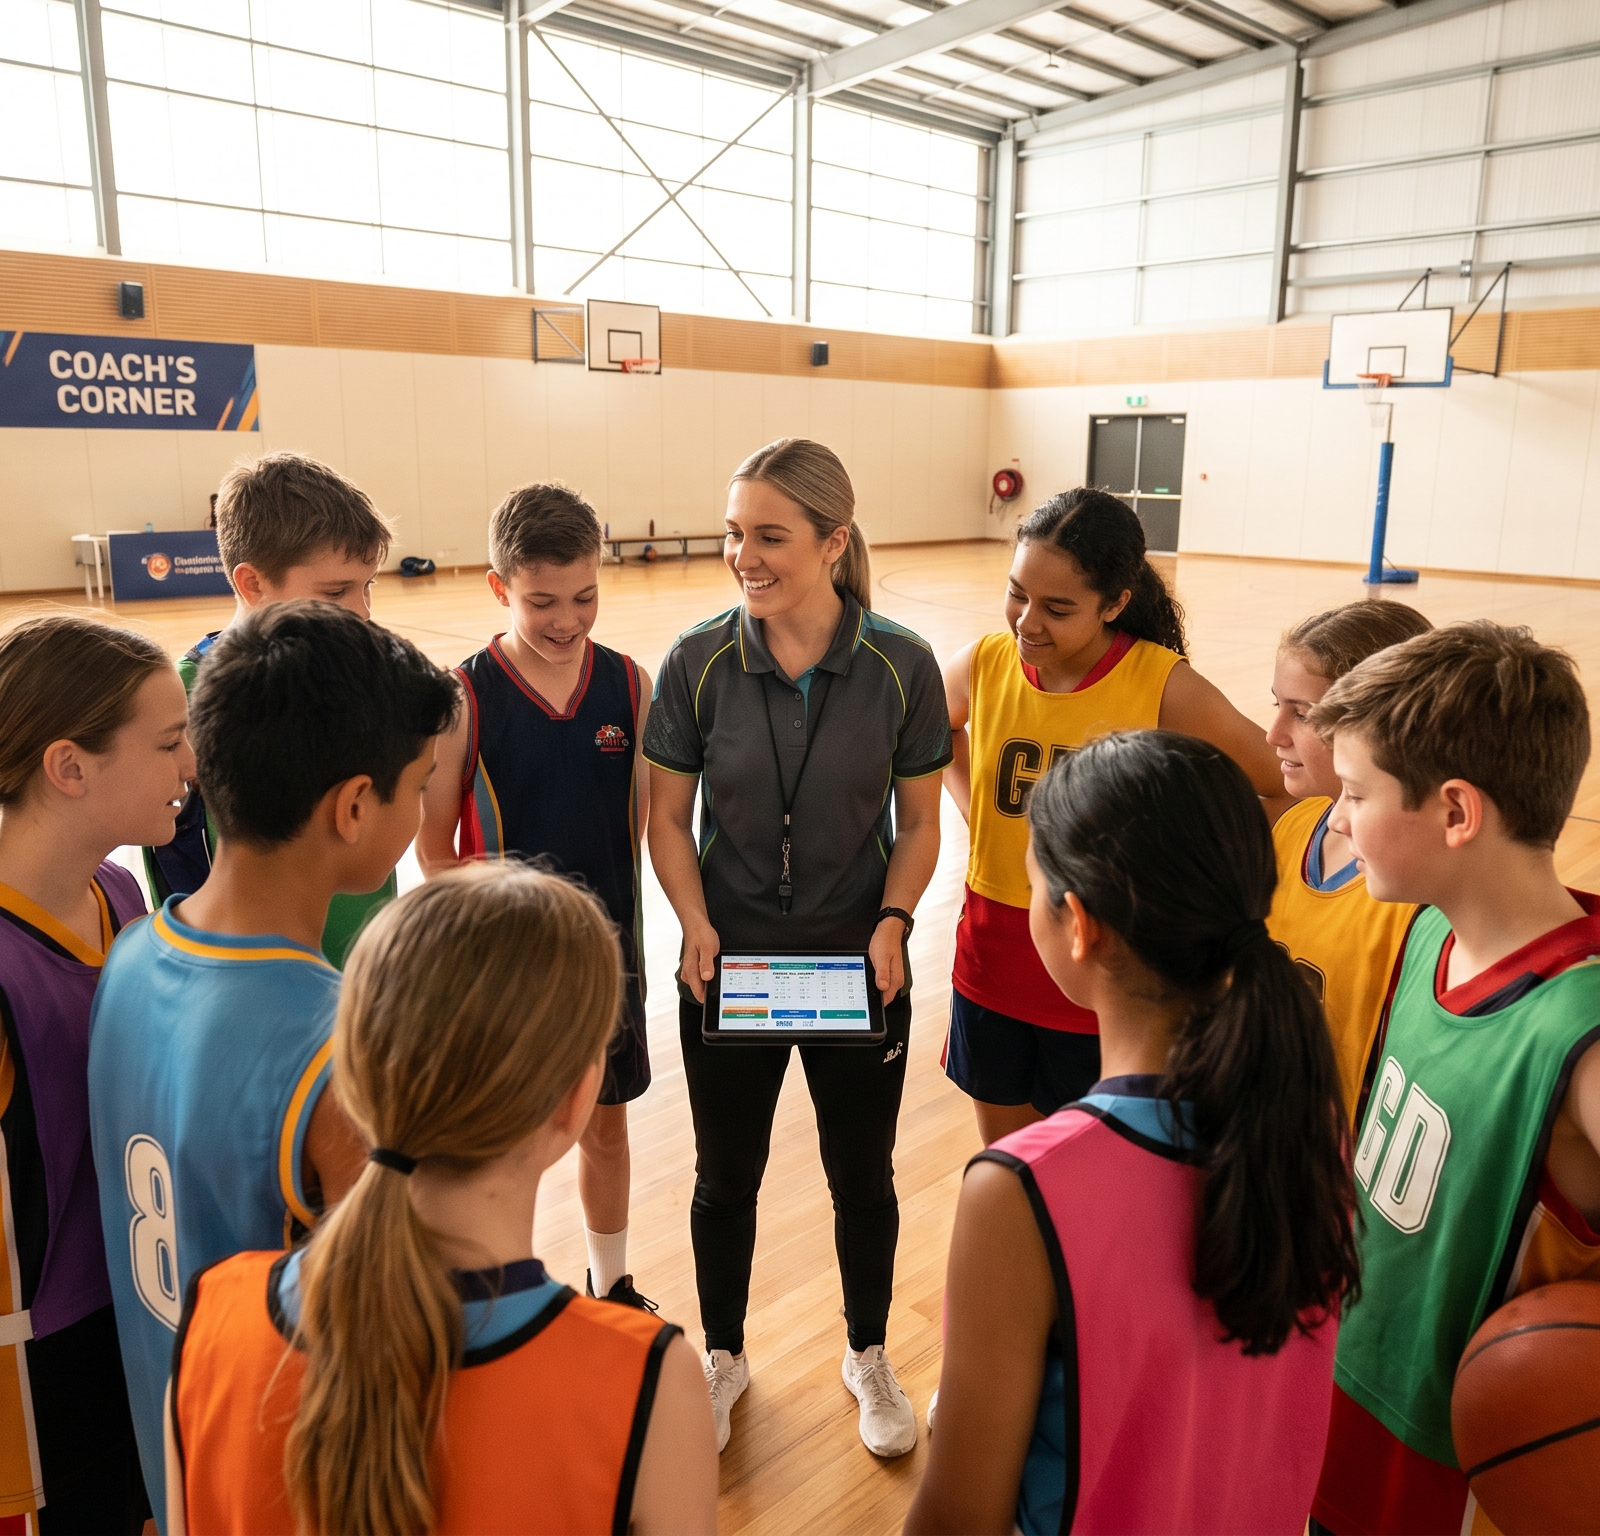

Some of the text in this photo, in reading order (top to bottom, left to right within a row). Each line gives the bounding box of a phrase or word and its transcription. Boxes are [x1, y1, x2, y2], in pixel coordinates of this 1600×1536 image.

[49, 349, 198, 384] COACH'S
[57, 384, 198, 416] CORNER
[994, 737, 1082, 819] G
[1354, 1055, 1451, 1235] GD
[125, 1133, 181, 1333] 8
